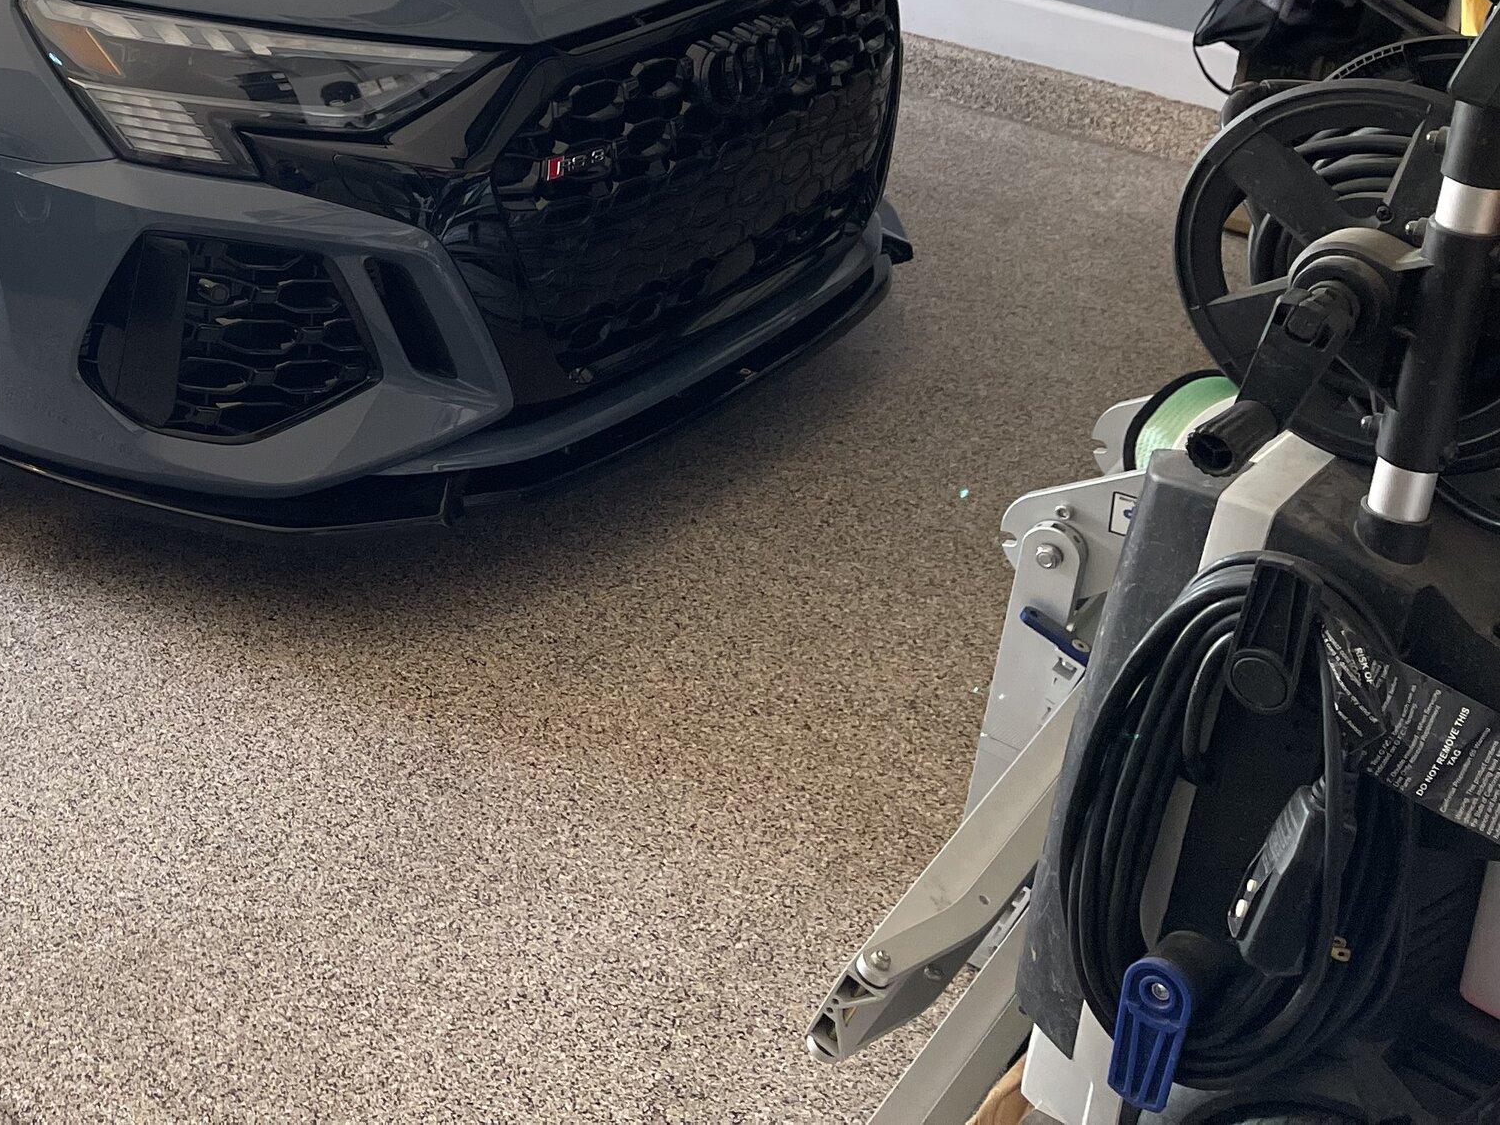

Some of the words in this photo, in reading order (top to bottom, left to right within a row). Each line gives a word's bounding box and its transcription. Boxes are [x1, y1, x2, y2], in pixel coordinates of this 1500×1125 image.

[1352, 646, 1369, 669] RISK
[1414, 781, 1428, 797] DO
[1424, 763, 1440, 783] NOT
[1435, 726, 1460, 765] REMOVE
[1453, 705, 1471, 727] THIS
[1446, 748, 1462, 766] TAG
